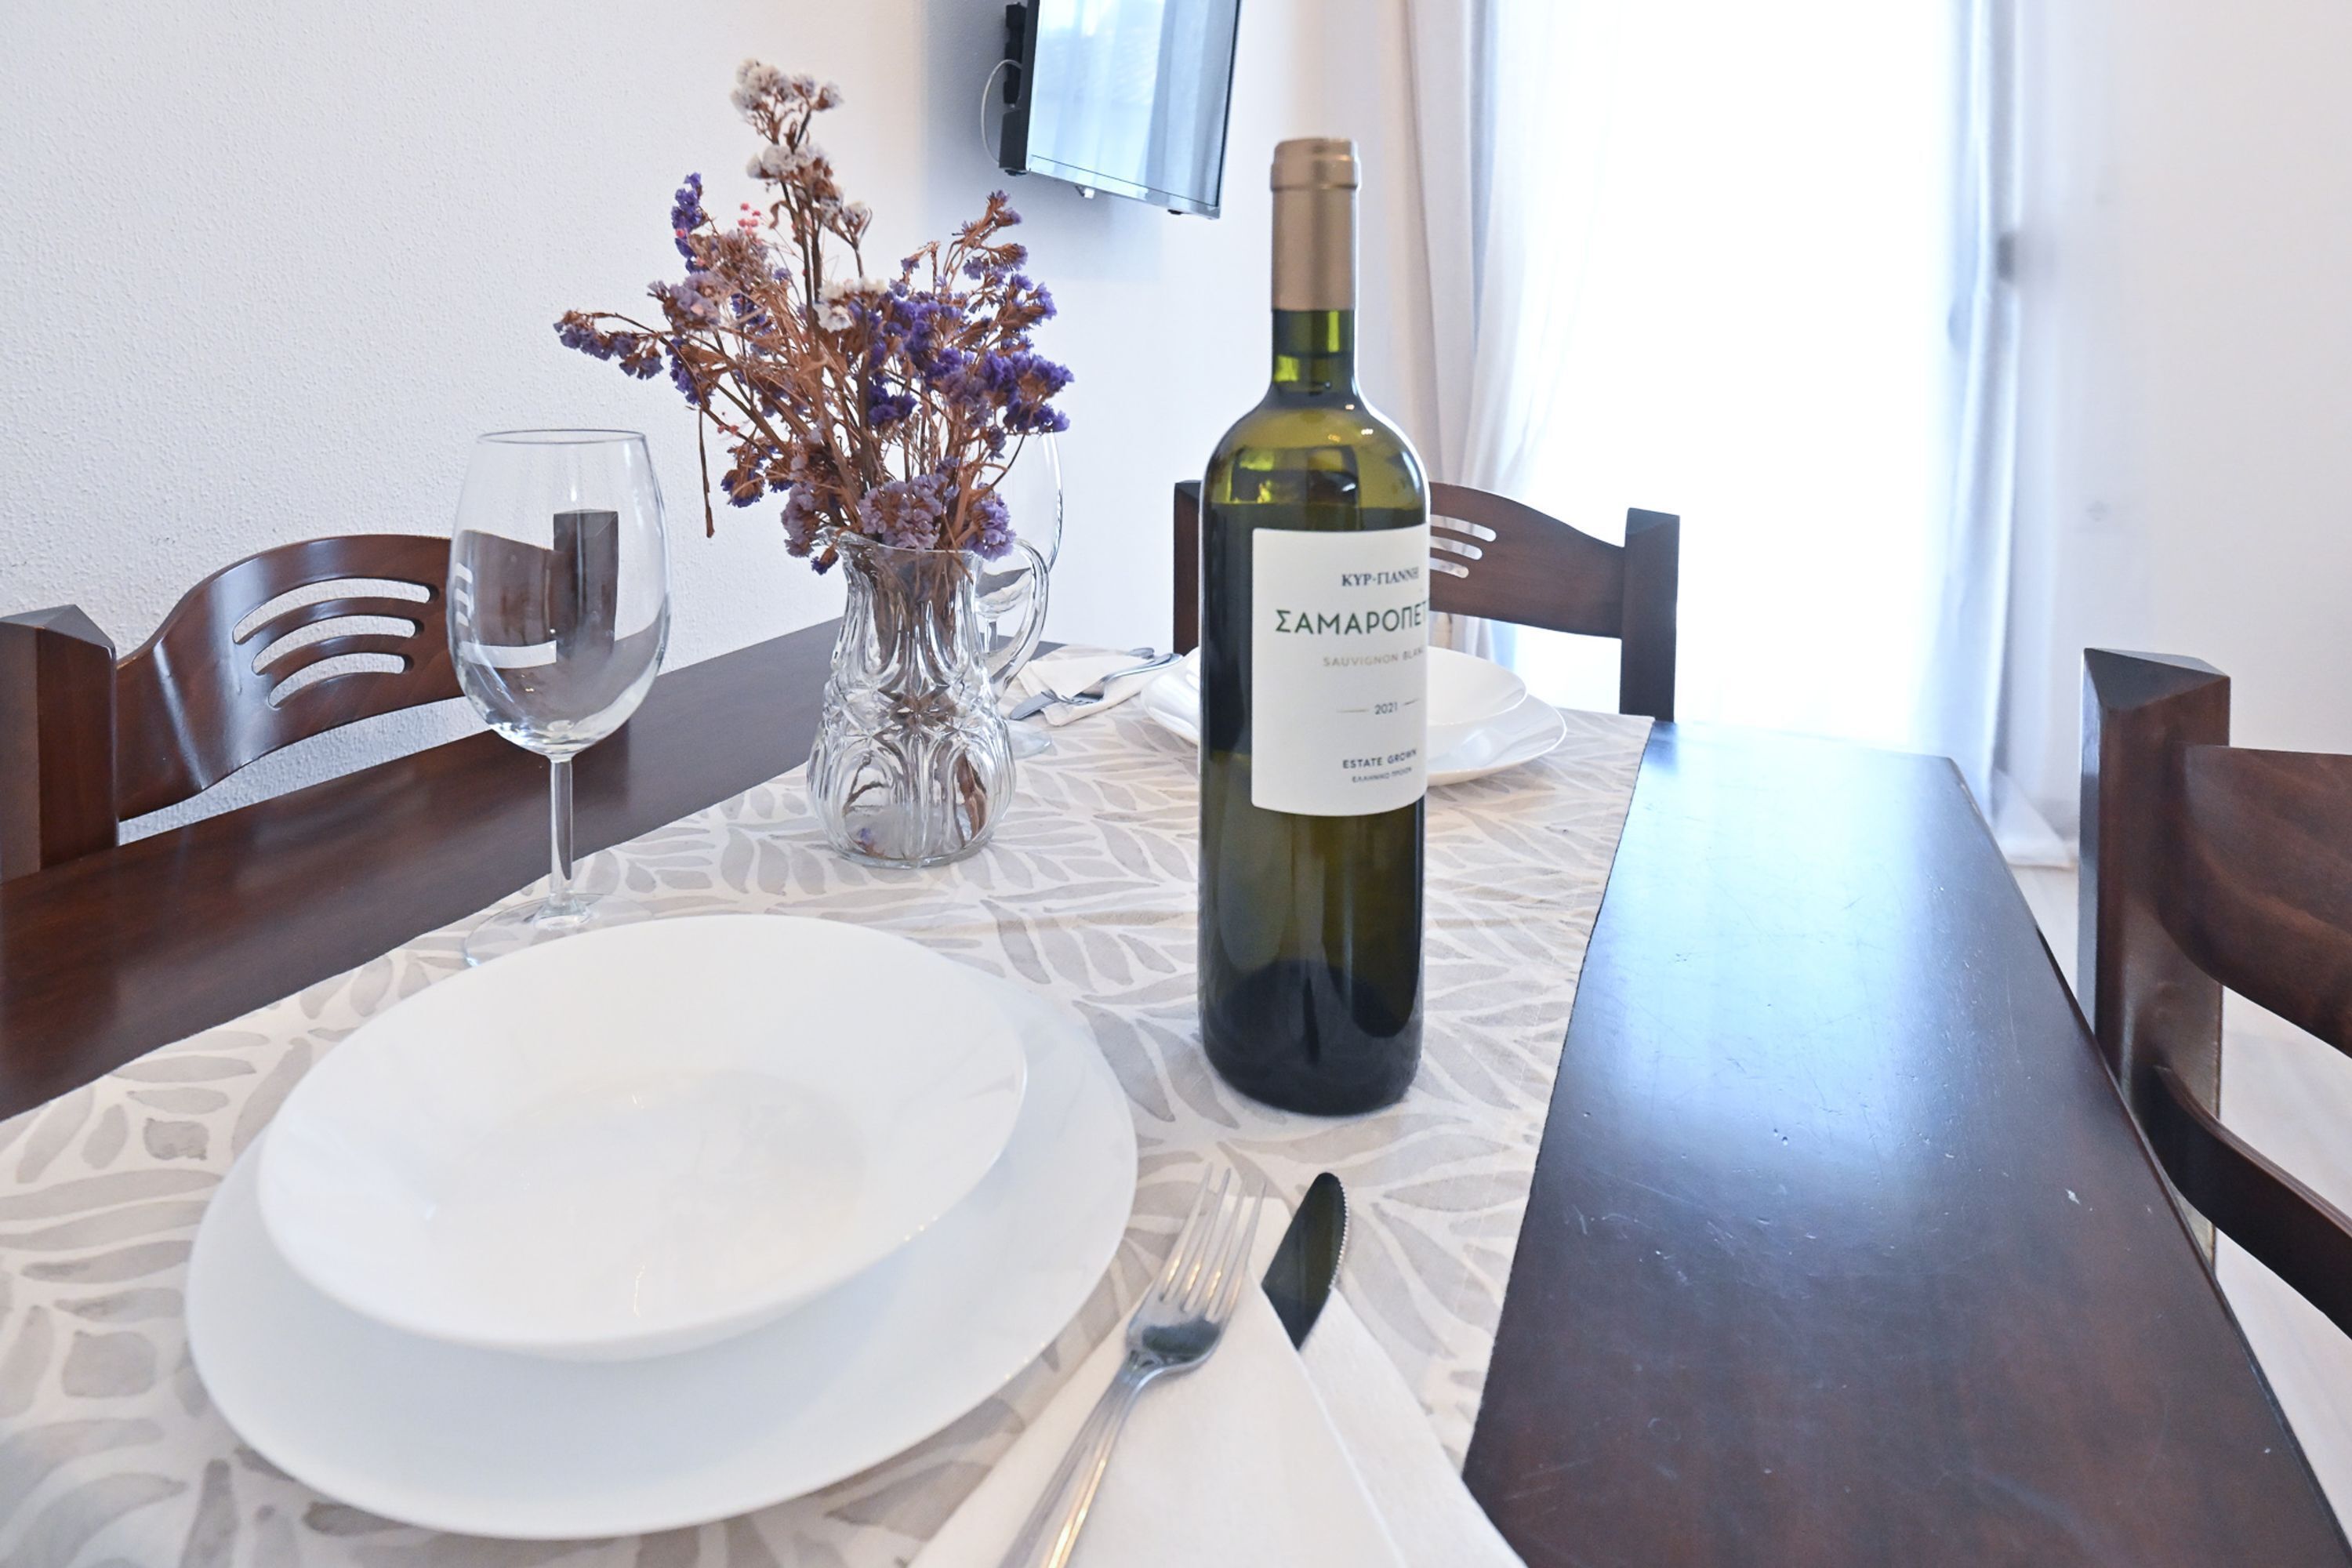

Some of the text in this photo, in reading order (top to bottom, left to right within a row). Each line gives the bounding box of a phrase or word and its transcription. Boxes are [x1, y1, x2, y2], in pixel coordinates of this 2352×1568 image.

[1323, 653, 1398, 666] SAUVIGNON
[1374, 702, 1398, 715] 2021
[1342, 757, 1382, 769] ESTATE
